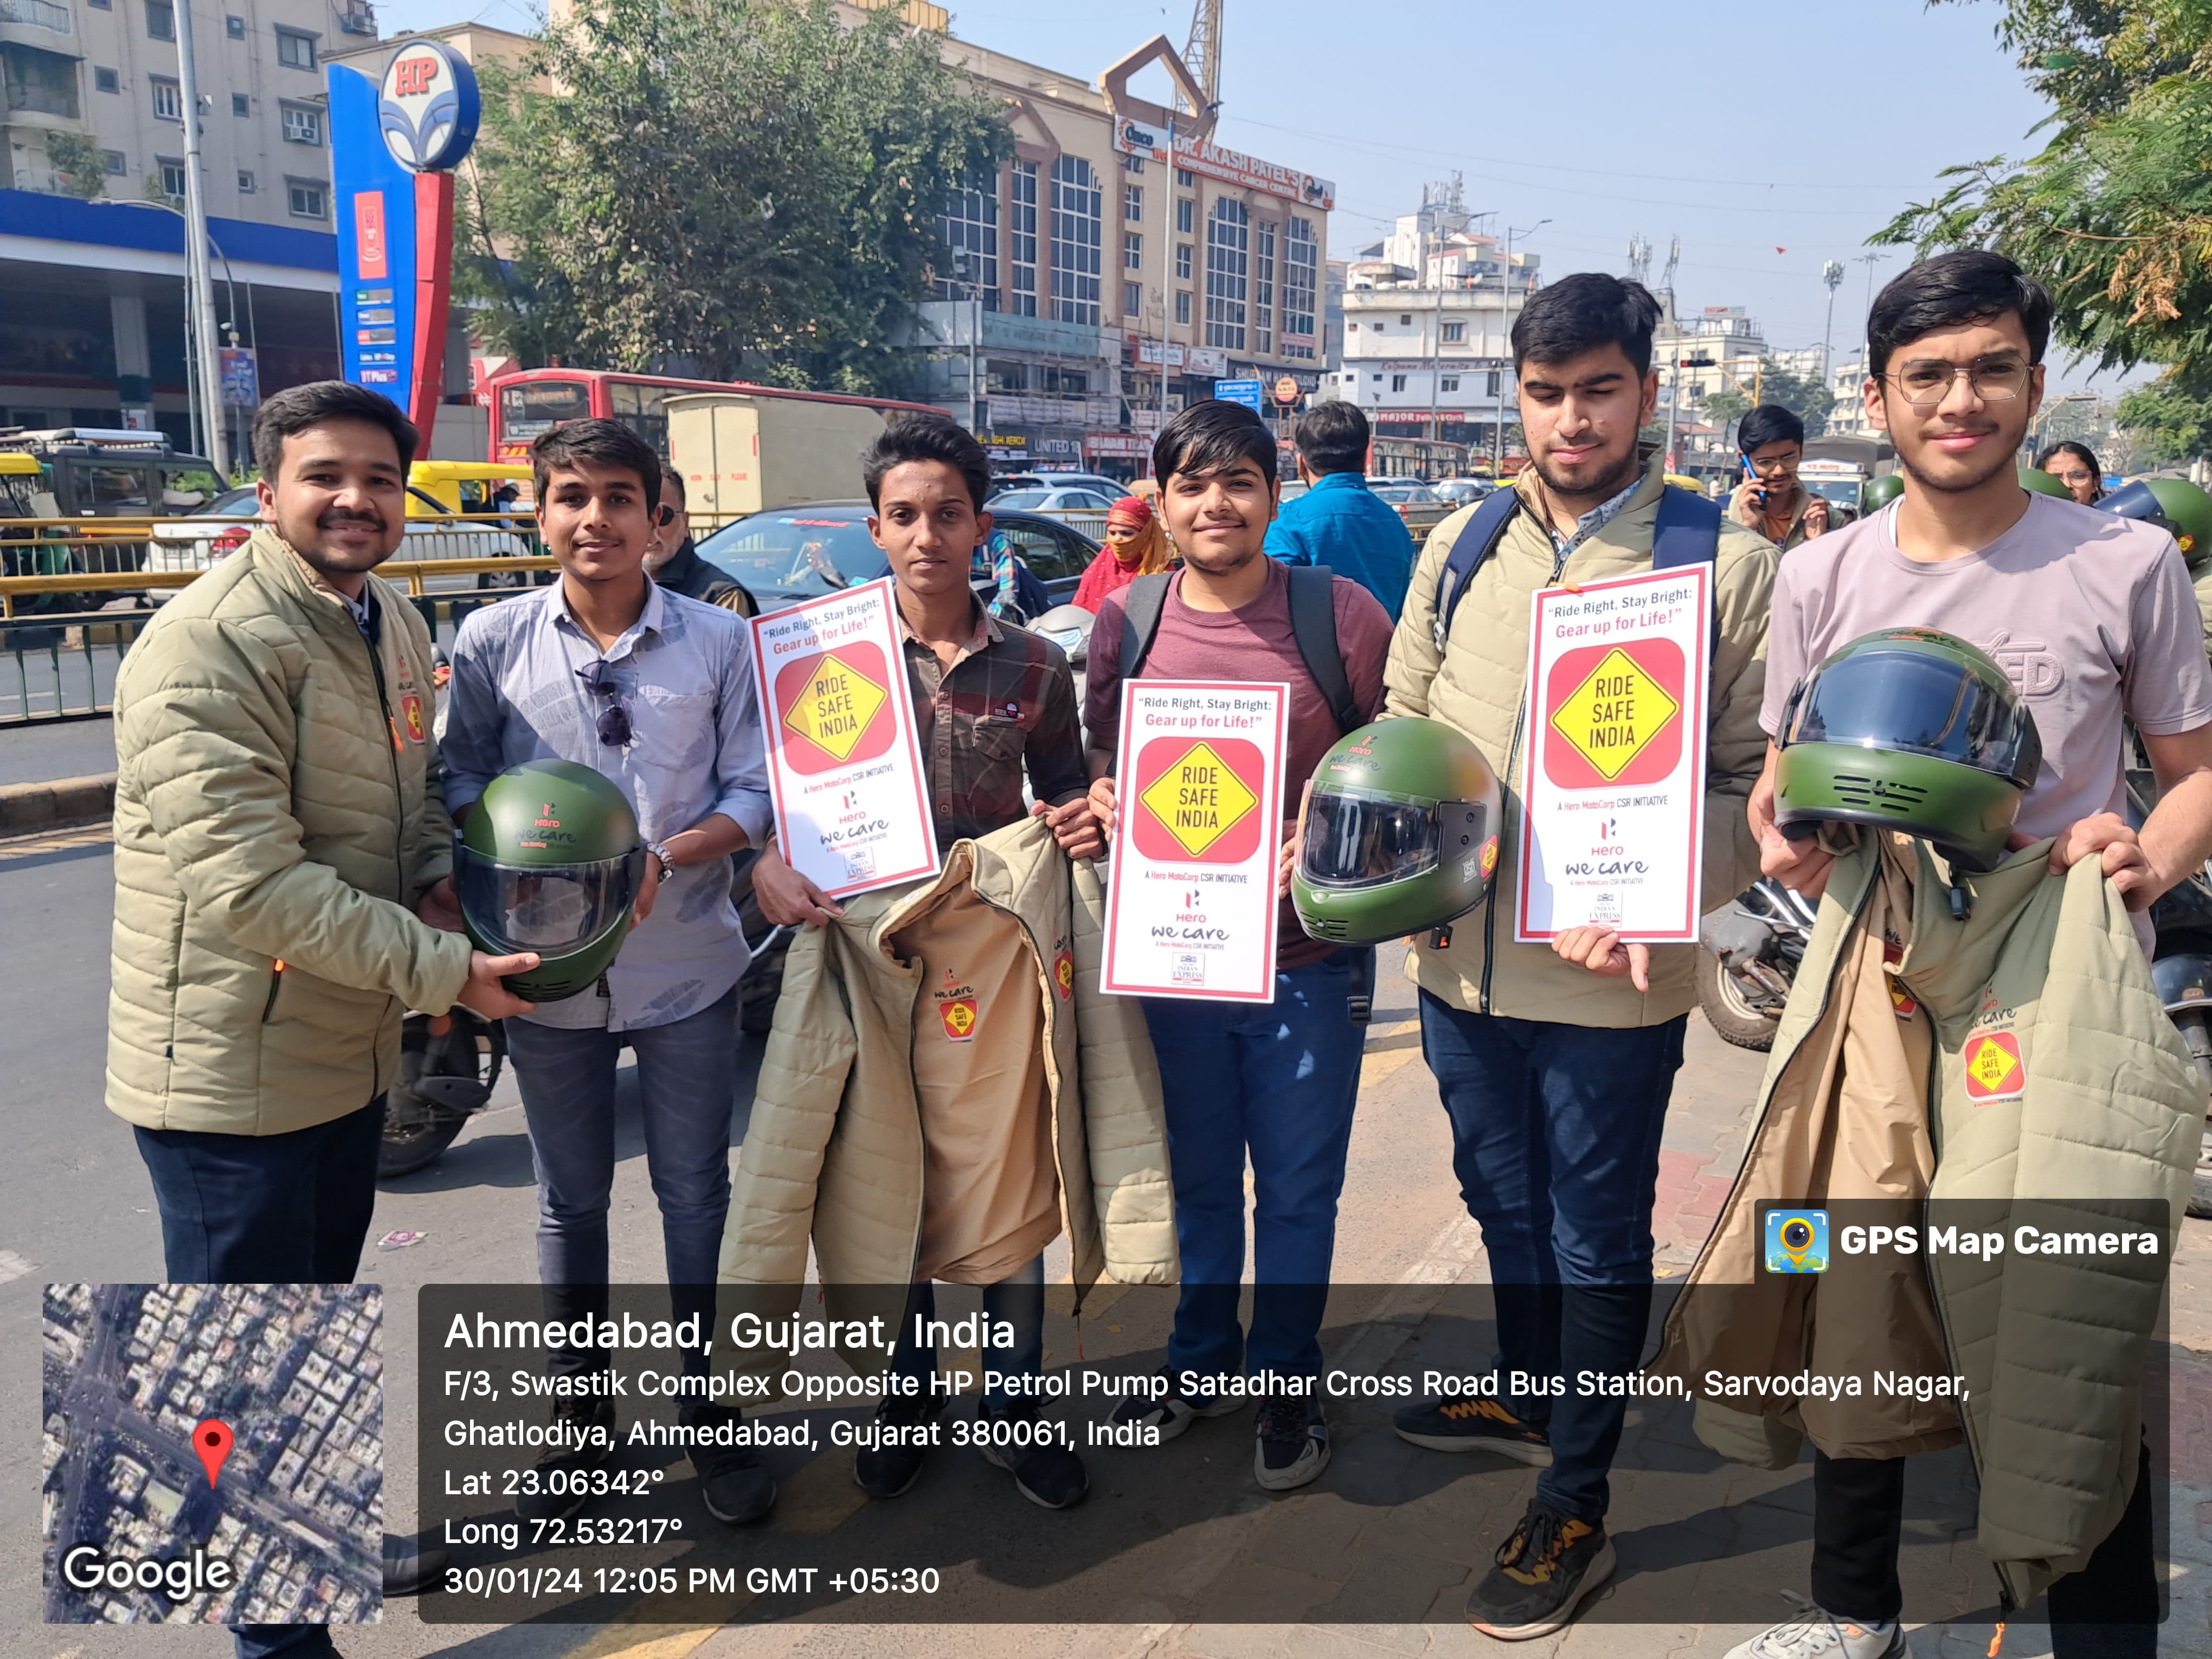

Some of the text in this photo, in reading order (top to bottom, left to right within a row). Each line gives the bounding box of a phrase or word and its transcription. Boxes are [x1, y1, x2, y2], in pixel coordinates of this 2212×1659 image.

[395, 56, 438, 95] HP
[1200, 143, 1247, 171] AKASH
[1250, 157, 1300, 187] PATEL'S
[1380, 413, 1415, 423] MAJOR
[1034, 439, 1069, 453] UNITED
[1583, 599, 1618, 615] Right,
[1621, 594, 1648, 609] Stay
[1650, 588, 1692, 605] Bright:
[792, 616, 822, 632] Right,
[824, 608, 845, 622] Stay
[846, 599, 880, 615] Bright:
[1555, 622, 1590, 639] Gear
[1593, 622, 1611, 635] up
[1615, 616, 1636, 631] for
[773, 639, 802, 655] Gear
[805, 635, 819, 649] up
[822, 627, 839, 641] for
[815, 673, 849, 698] RIDE
[1595, 674, 1635, 699] RIDE
[818, 693, 853, 718] SAFE
[1172, 698, 1204, 710] Right,
[1207, 698, 1231, 711] Stay
[1234, 699, 1272, 712] Bright:
[1592, 699, 1635, 724] SAFE
[819, 713, 858, 739] INDIA
[1145, 713, 1178, 726] Gear
[1180, 716, 1197, 729] up
[1201, 714, 1220, 728] for
[1589, 724, 1636, 749] INDIA
[1346, 756, 1381, 771] care
[804, 763, 895, 795] A Hero MotoCorp CSR INITIATIVE
[1182, 766, 1218, 785] RIDE
[1178, 787, 1219, 807] SAFE
[1557, 795, 1669, 811] A Hero MotoCorp CSR INITIATIVE
[1175, 809, 1219, 829] INDIA
[539, 829, 577, 843] care
[820, 819, 890, 846] we care
[1144, 870, 1249, 884] A Hero MotoCorp CSR INITIATIVE
[1565, 860, 1649, 876] we care
[1151, 925, 1230, 941] we care
[949, 986, 974, 997] care
[1983, 1007, 2017, 1025] care
[1982, 1047, 1997, 1059] RIDE
[1981, 1058, 1999, 1070] SAFE
[1982, 1068, 2002, 1081] INDIA
